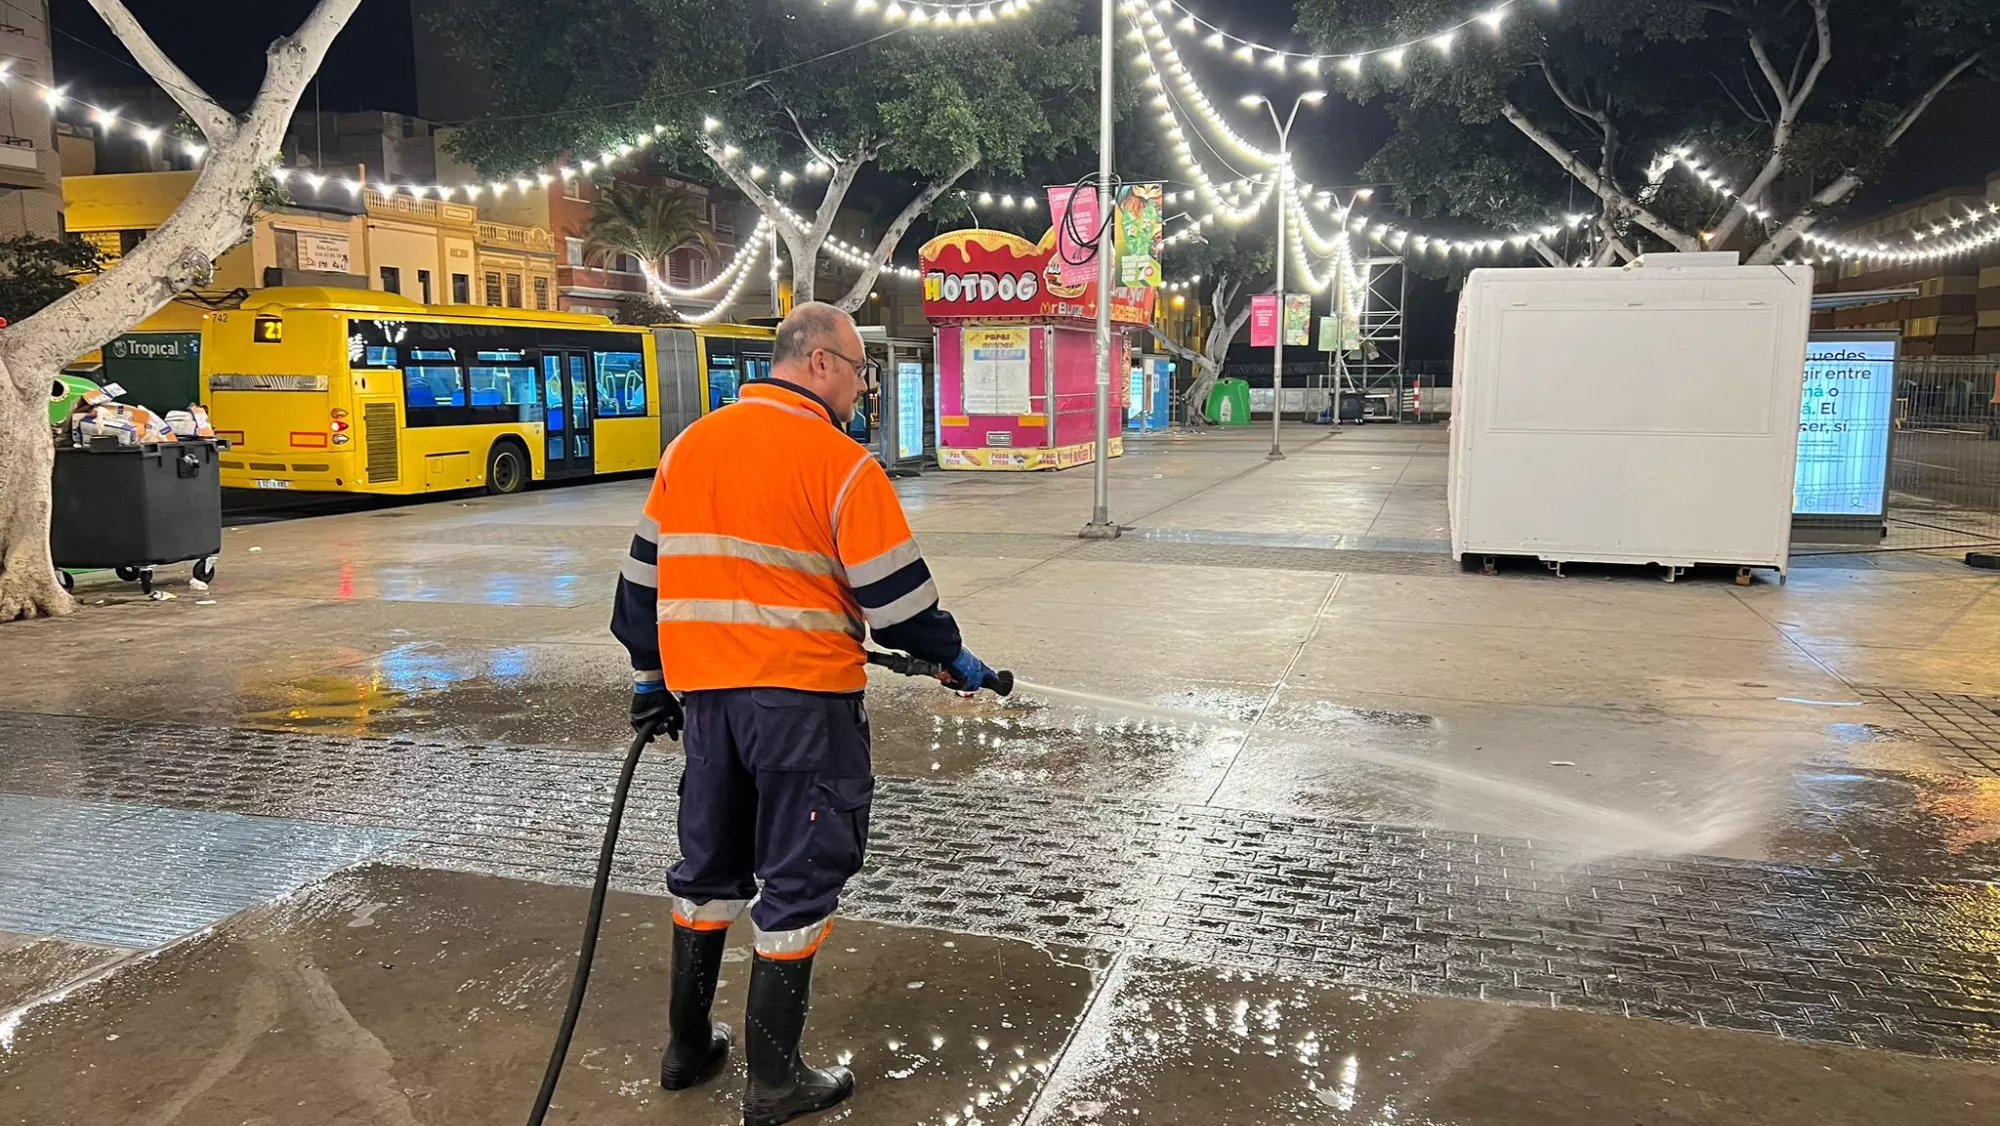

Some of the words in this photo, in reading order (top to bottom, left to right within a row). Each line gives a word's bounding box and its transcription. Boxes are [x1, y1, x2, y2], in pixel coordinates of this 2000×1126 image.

[923, 267, 1039, 303] HOTDOG
[212, 313, 228, 323] 742
[264, 321, 283, 339] 21
[127, 339, 180, 358] Tropical
[1810, 349, 1867, 362] uedes
[1825, 368, 1872, 380] entre
[1828, 387, 1840, 398] o
[1820, 402, 1837, 415] El
[1834, 419, 1851, 432] sí.
